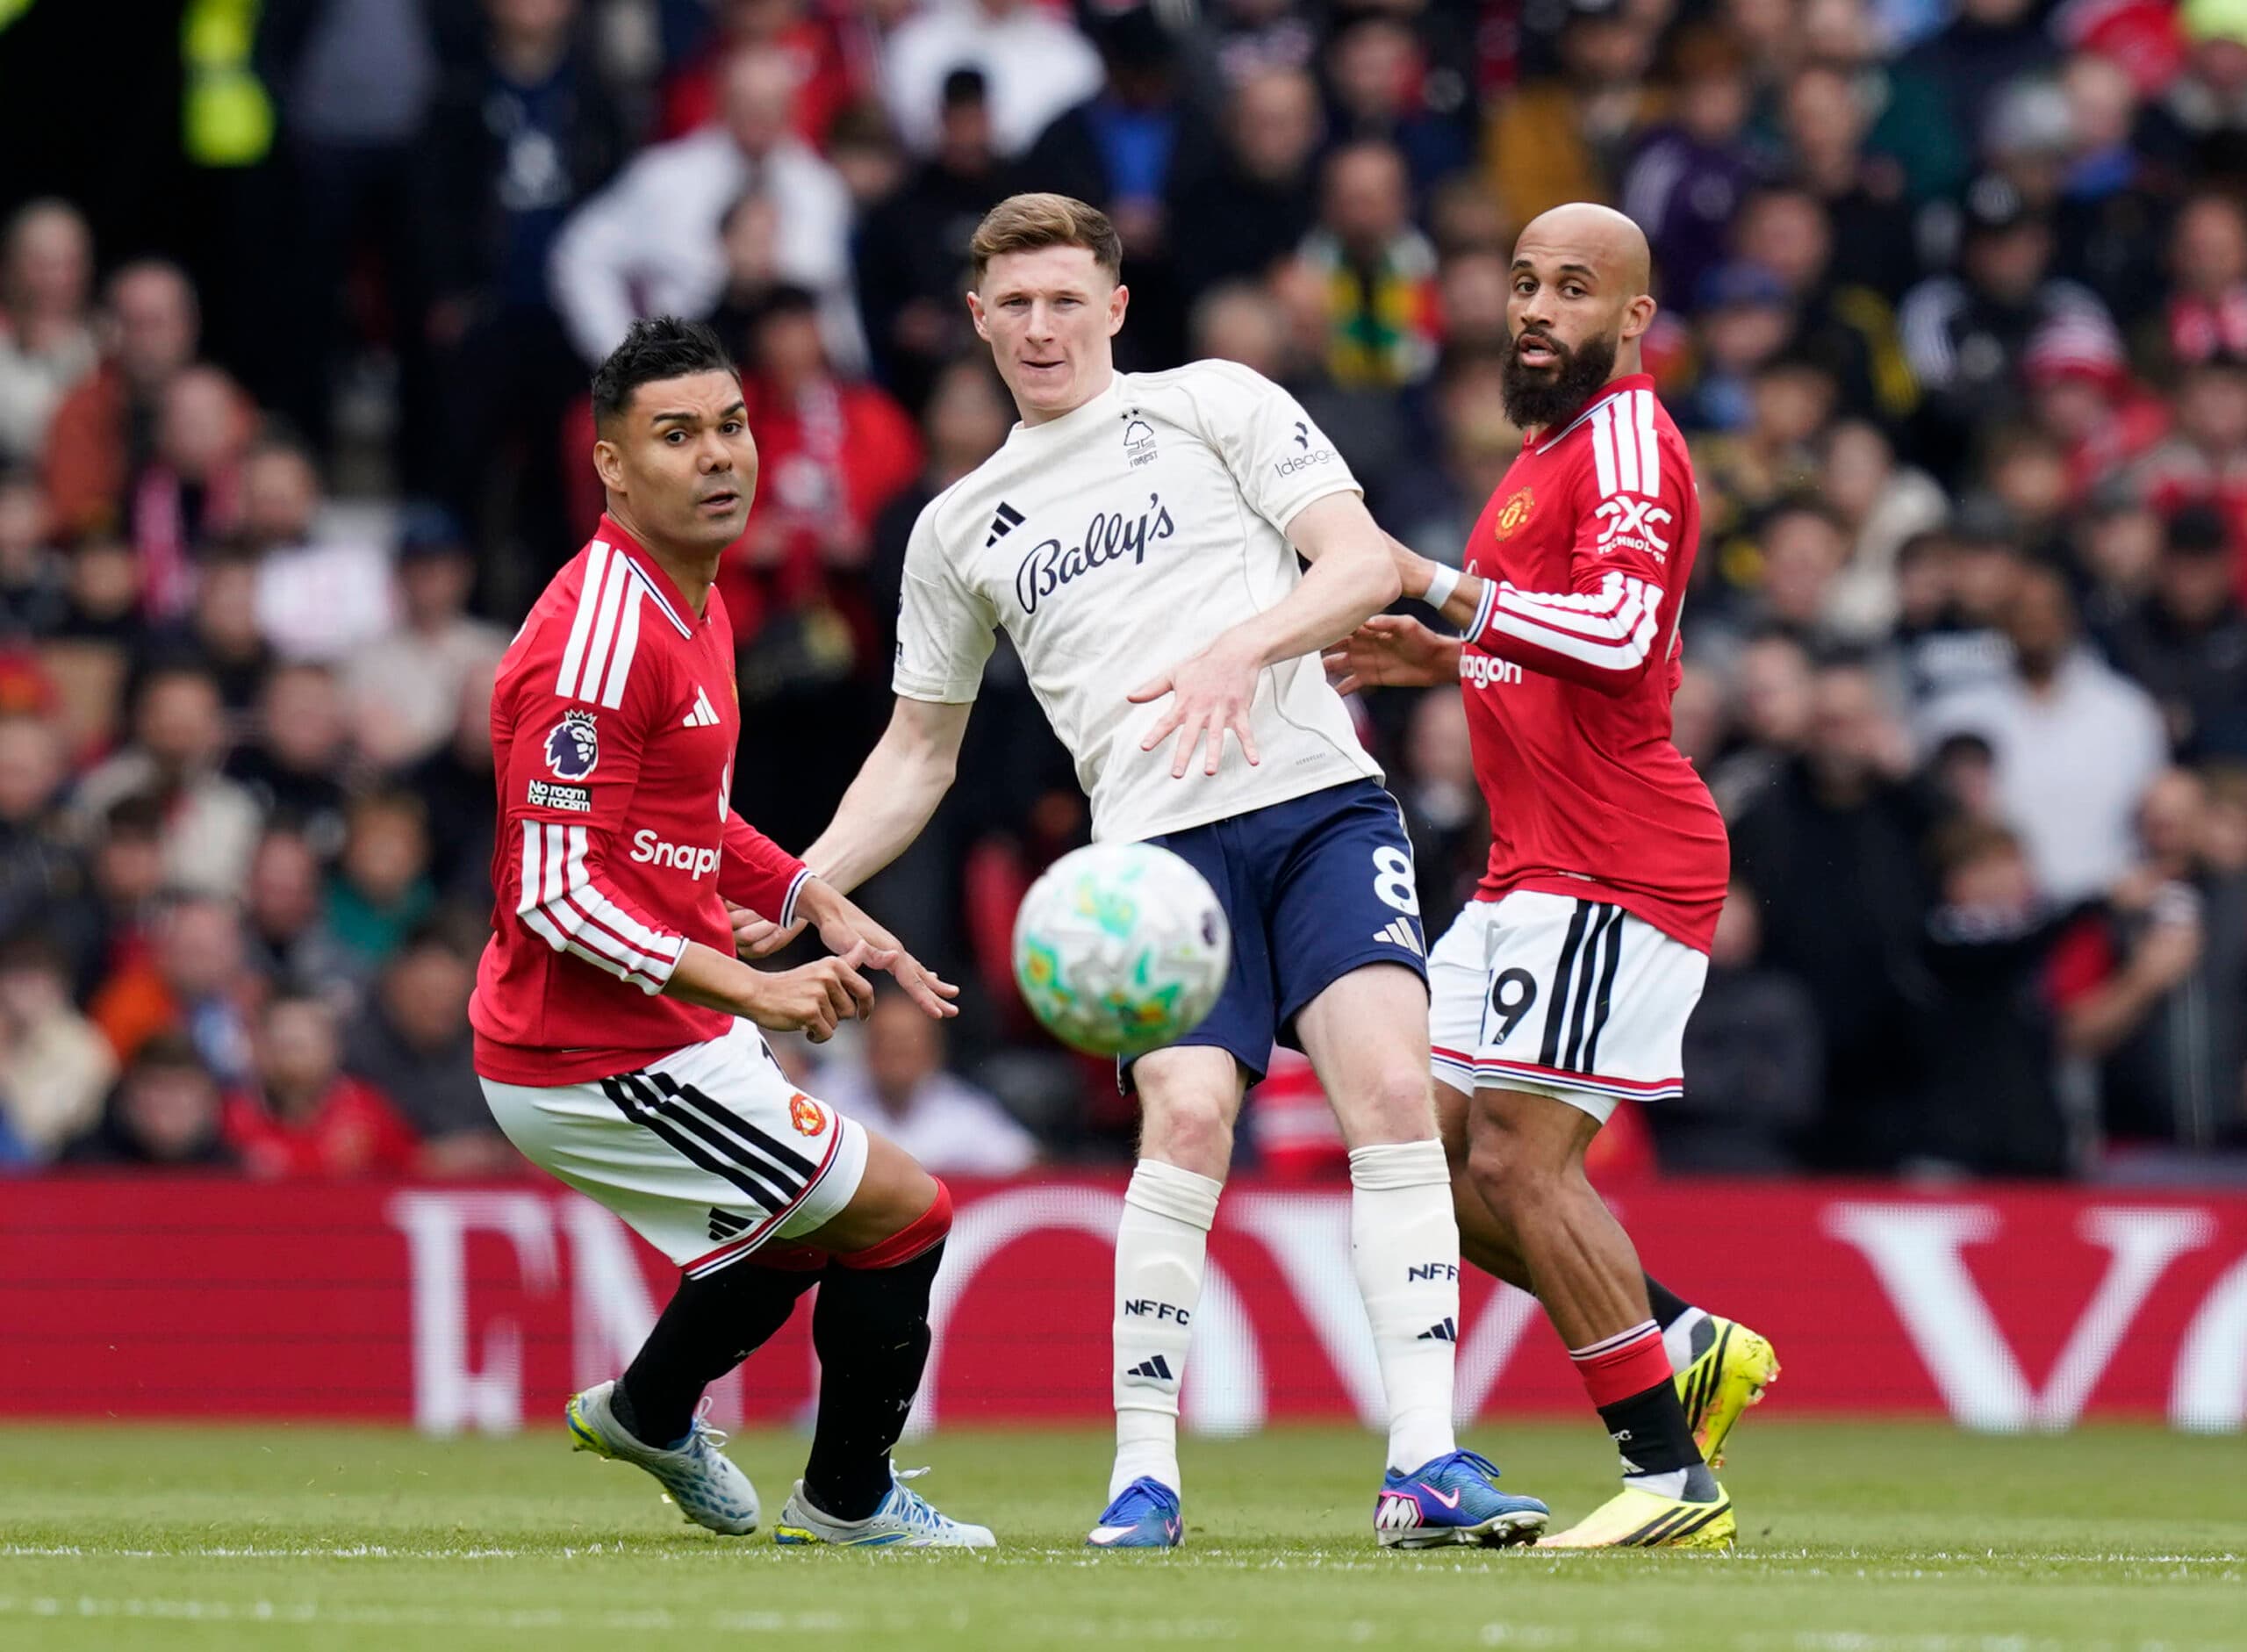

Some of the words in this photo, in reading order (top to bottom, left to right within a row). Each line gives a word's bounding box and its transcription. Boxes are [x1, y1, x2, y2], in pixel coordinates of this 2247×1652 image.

[1016, 492, 1174, 614] Bally's
[528, 779, 549, 795] No
[549, 785, 587, 801] room
[528, 794, 547, 807] for
[547, 796, 592, 812] racism
[630, 829, 722, 881] Snap
[1372, 845, 1420, 916] 8
[1478, 966, 1538, 1045] 9
[1408, 1262, 1461, 1282] NFF
[1124, 1298, 1190, 1325] NFFC
